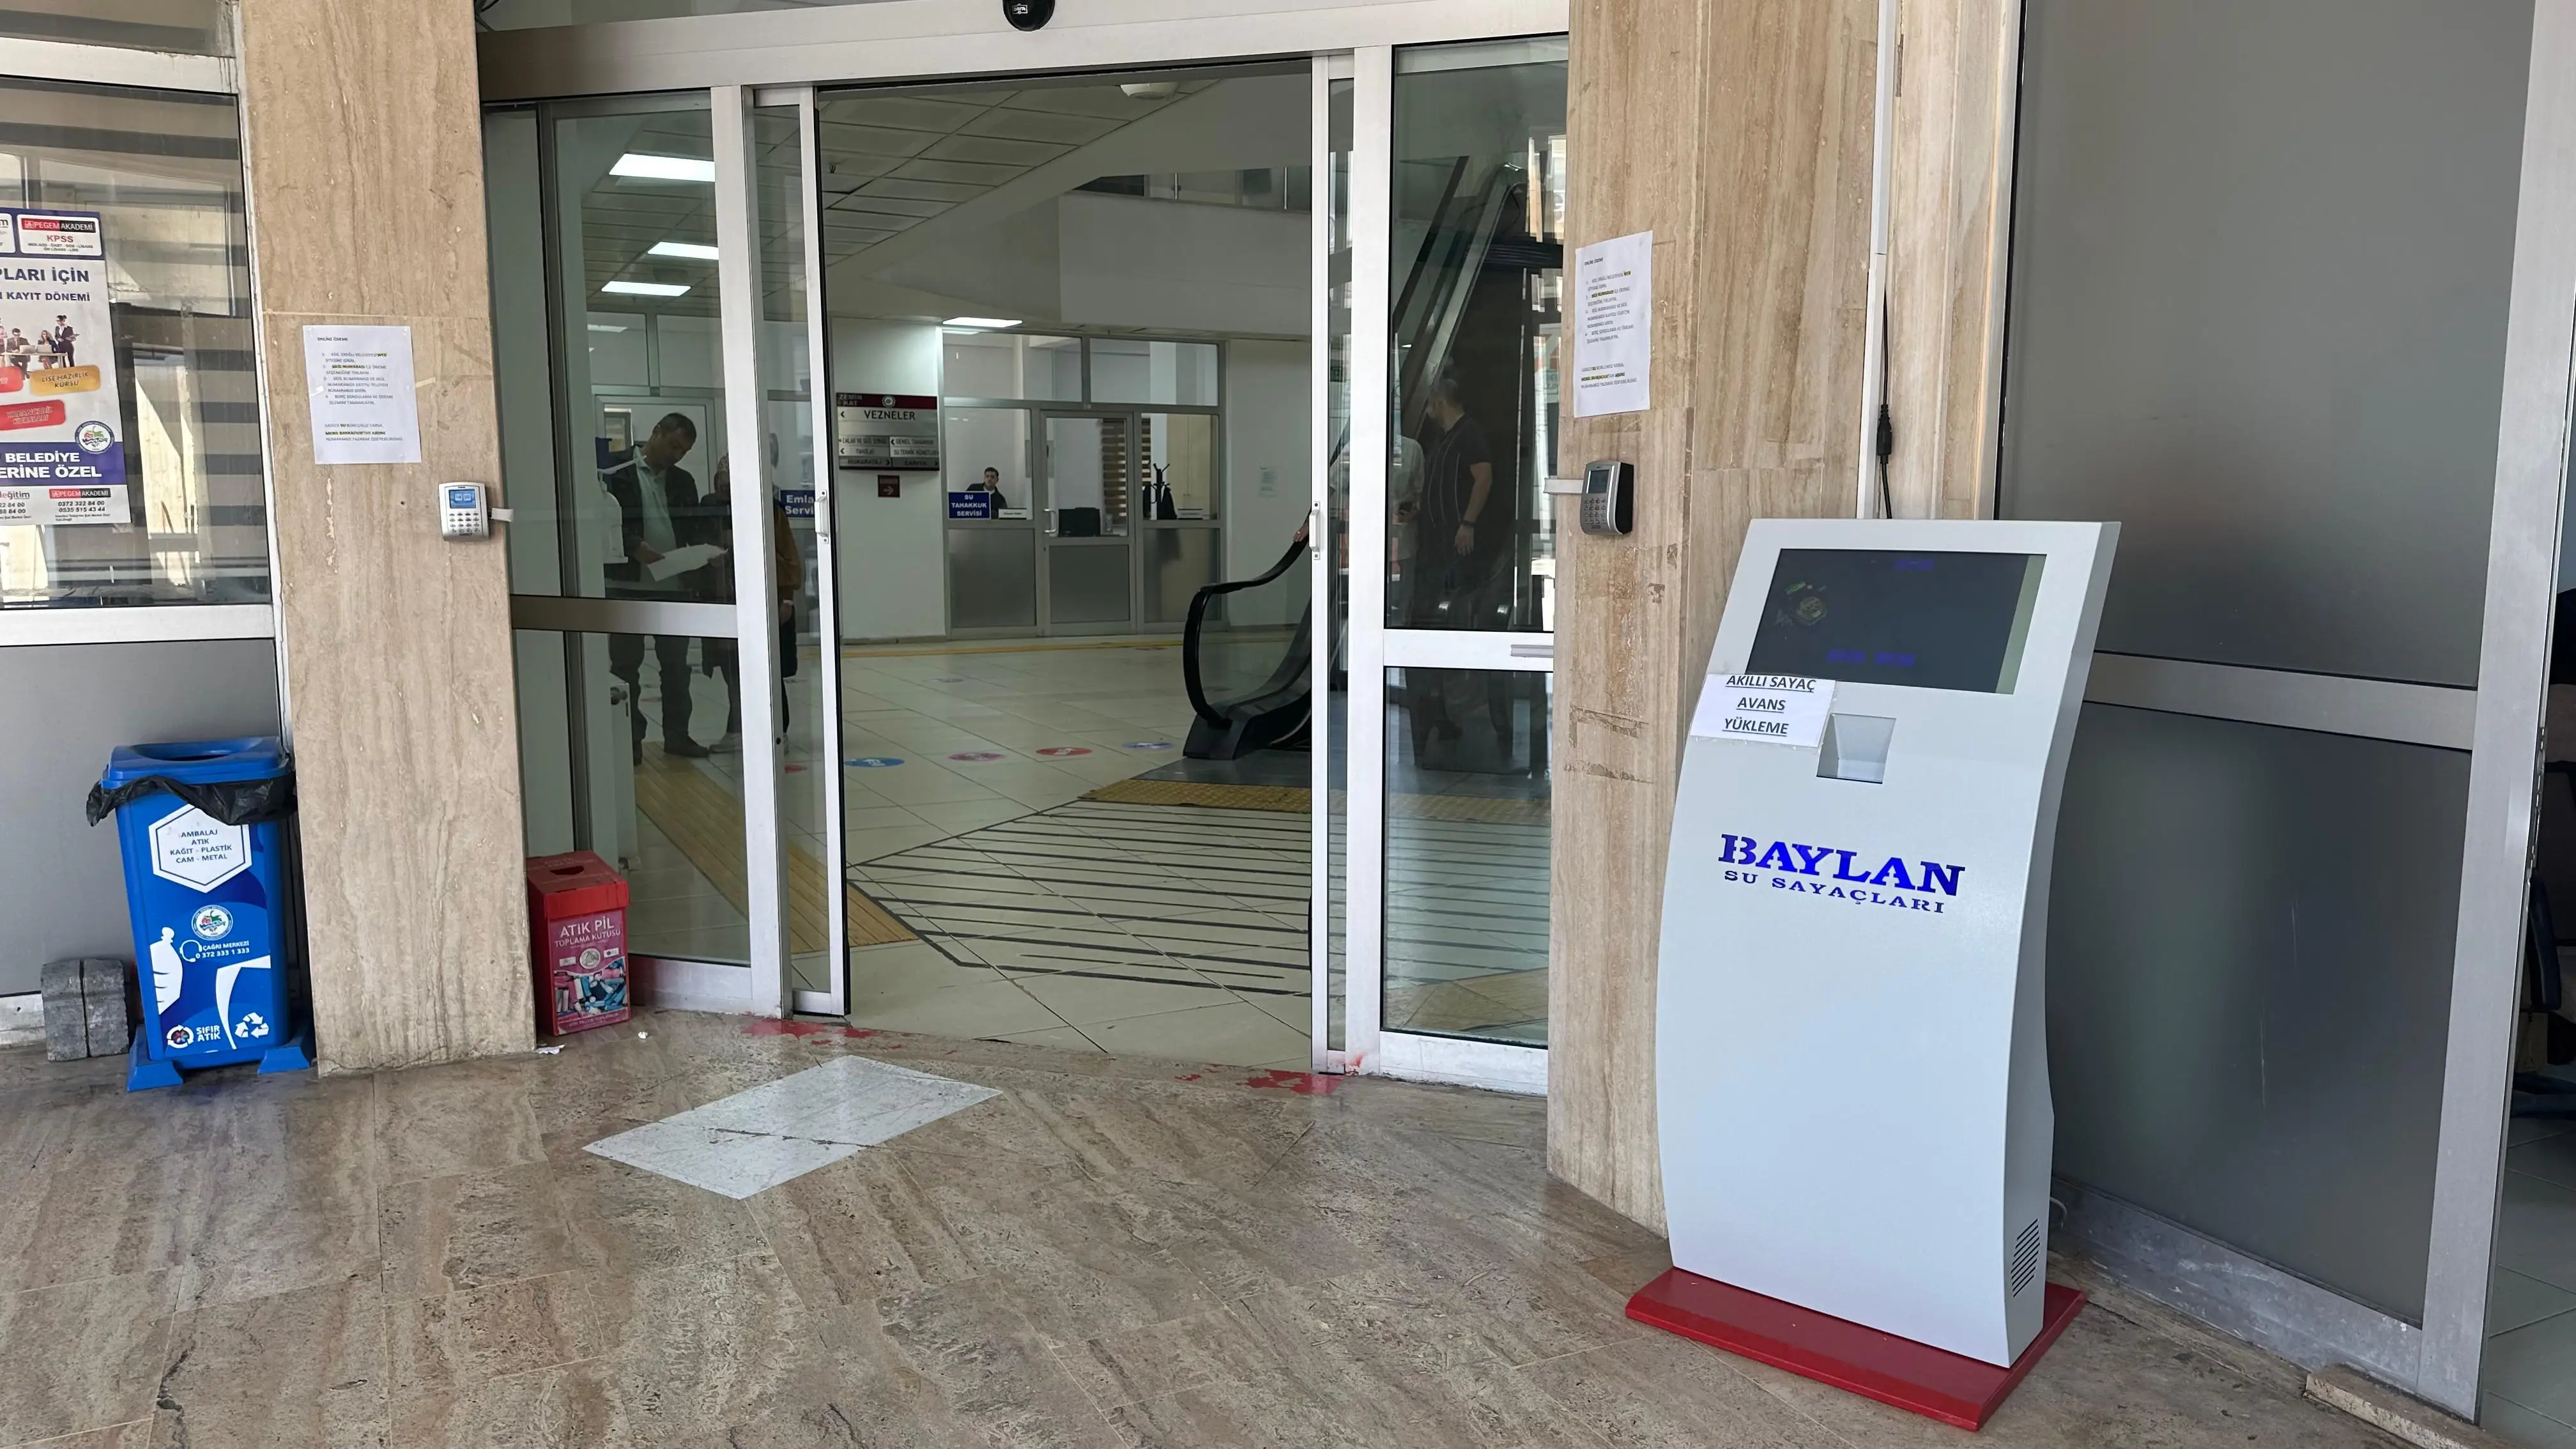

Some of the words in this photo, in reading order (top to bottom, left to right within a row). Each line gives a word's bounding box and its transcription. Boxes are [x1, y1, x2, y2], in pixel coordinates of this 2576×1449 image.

[52, 266, 89, 285] İÇİN
[6, 291, 41, 300] KAYIT
[45, 291, 90, 302] DÖNEMİ
[864, 410, 916, 420] VEZNELER
[5, 450, 80, 463] BELEDİYE
[55, 464, 102, 478] ÖZEL
[1726, 675, 1767, 686] AKILLI
[1769, 676, 1817, 692] SAYAÇ
[1737, 696, 1786, 711] AVANS
[1724, 716, 1790, 735] YÜKLEME
[181, 829, 218, 838] AMBALAJ
[201, 844, 233, 853] PLASTİK
[1718, 833, 1966, 897] BAYLAN
[1724, 870, 1758, 884] SU
[1772, 877, 1945, 914] SAYAÇLARI
[560, 921, 591, 938] ATIK
[594, 916, 615, 931] PİL
[554, 935, 591, 947] TOPLAMA
[592, 928, 622, 941] KUTUSU
[203, 943, 222, 951] ÇAĞRI
[222, 940, 250, 949] MERKEZİ
[195, 1025, 220, 1035] SIFIR
[197, 1033, 221, 1042] ATIK
